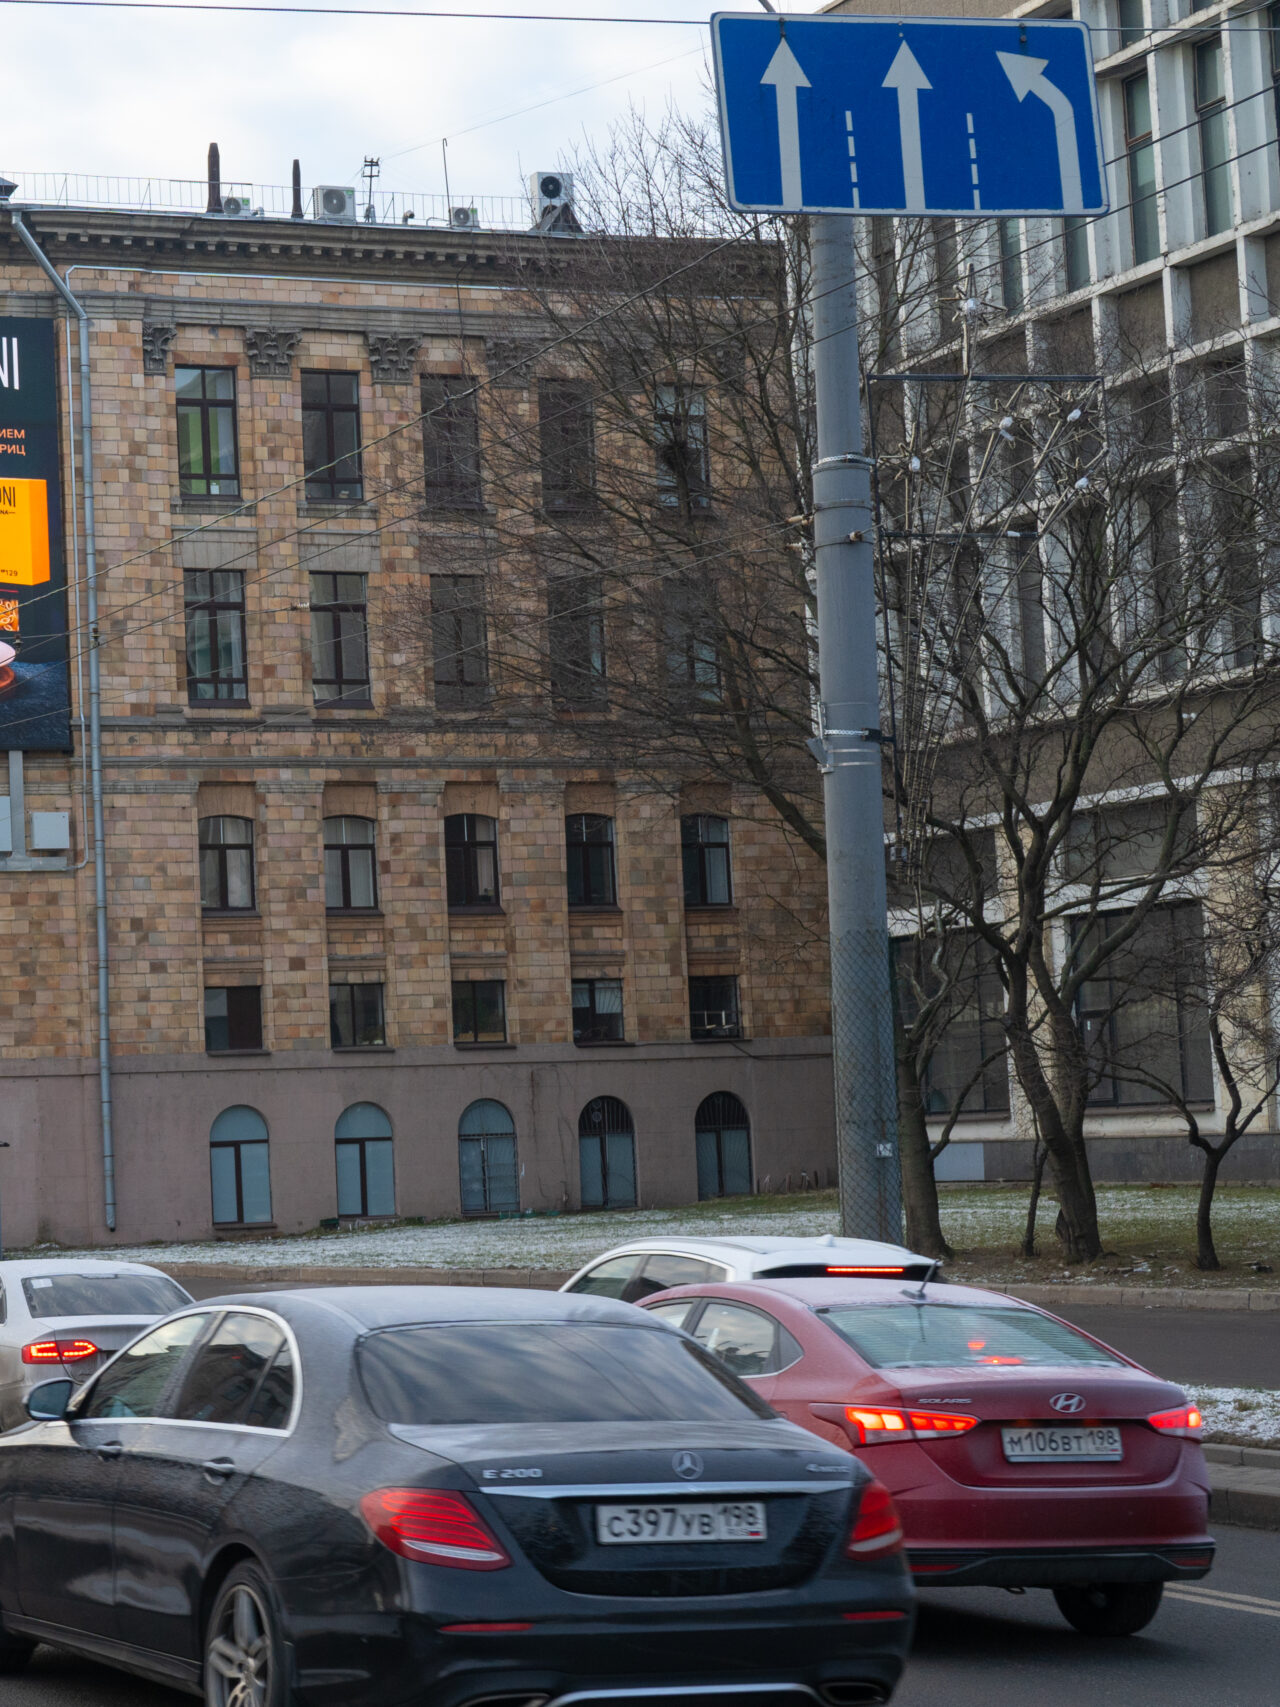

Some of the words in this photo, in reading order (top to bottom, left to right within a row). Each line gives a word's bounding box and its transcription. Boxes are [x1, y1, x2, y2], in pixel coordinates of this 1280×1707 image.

[1008, 1431, 1083, 1453] М106ВТ
[1086, 1429, 1117, 1446] 198
[482, 1469, 499, 1479] E
[500, 1468, 543, 1479] 200
[607, 1507, 715, 1538] С397УВ
[719, 1505, 758, 1527] 198
